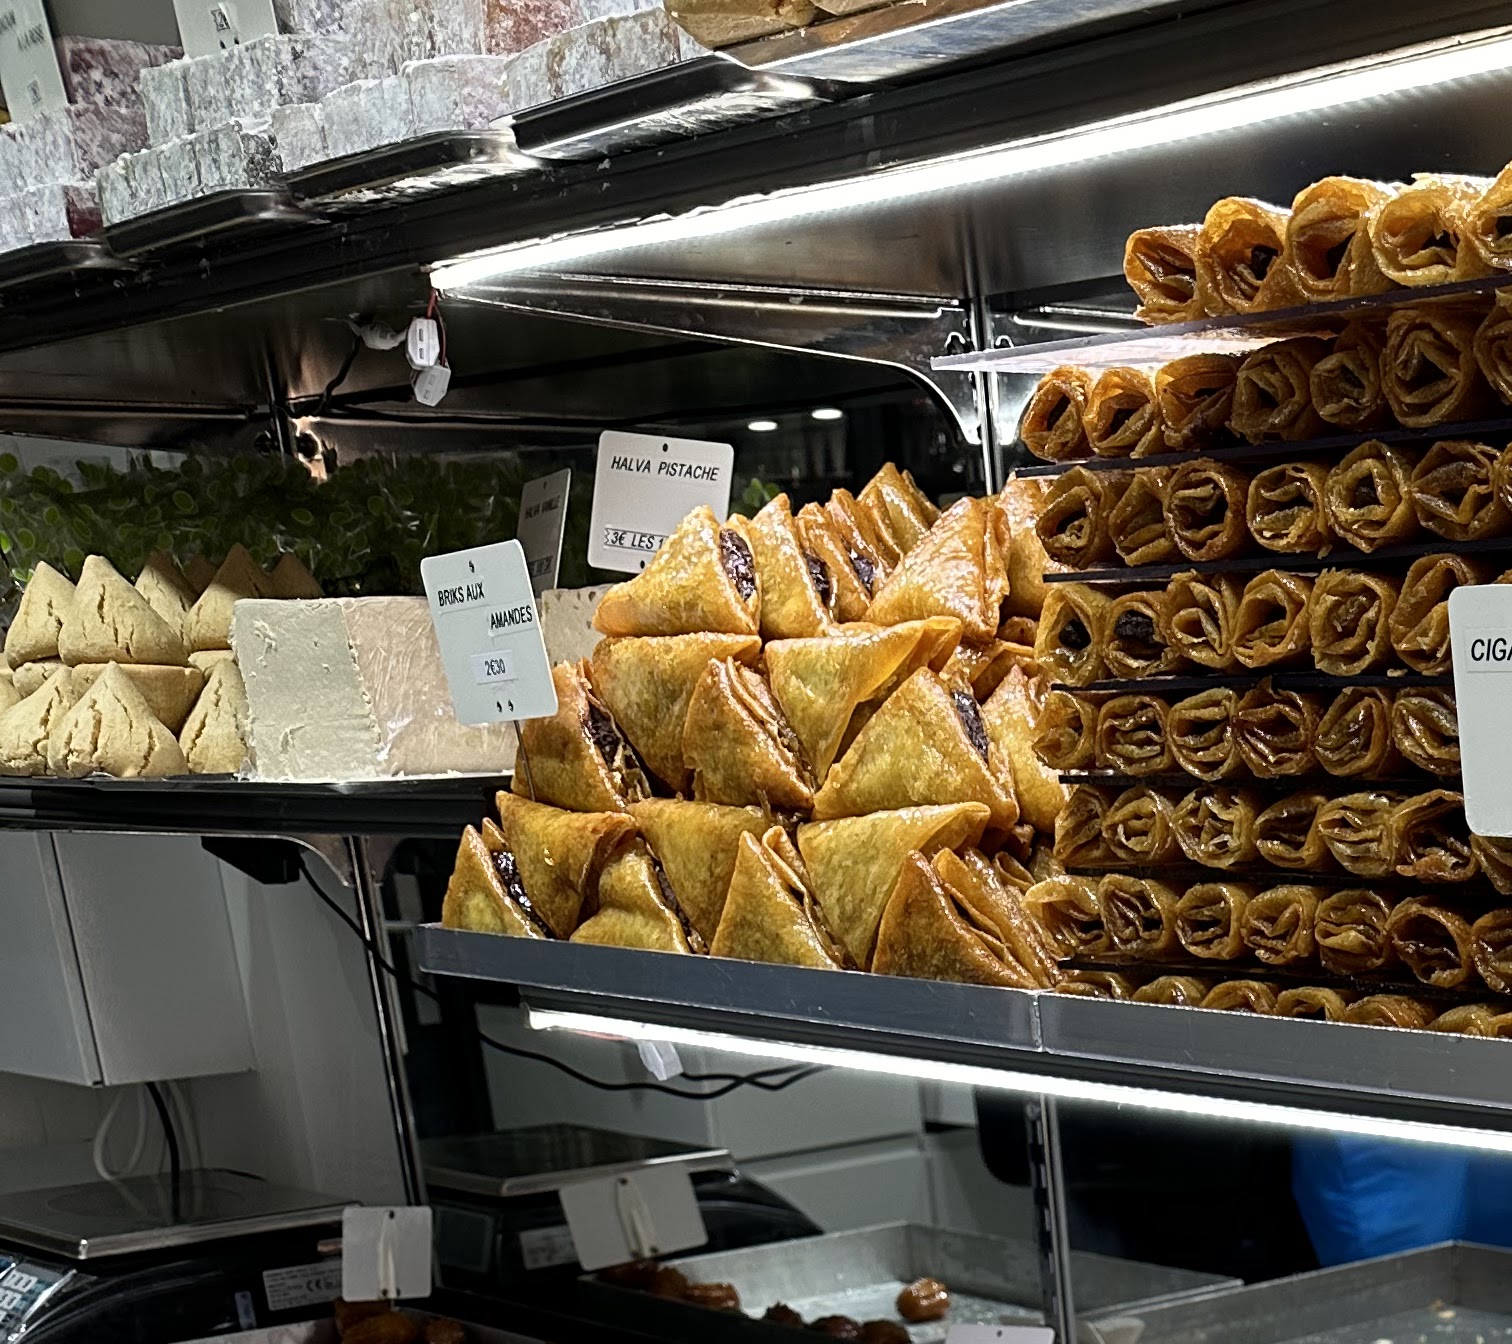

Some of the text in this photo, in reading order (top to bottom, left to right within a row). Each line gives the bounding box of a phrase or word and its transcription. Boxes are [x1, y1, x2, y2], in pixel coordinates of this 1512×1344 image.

[611, 456, 720, 481] HALVA PISTACHE
[611, 531, 625, 546] 3€
[632, 533, 653, 550] LES
[438, 582, 485, 607] BRIKS AUX
[490, 605, 533, 630] AMANDES
[485, 658, 506, 676] 2€30
